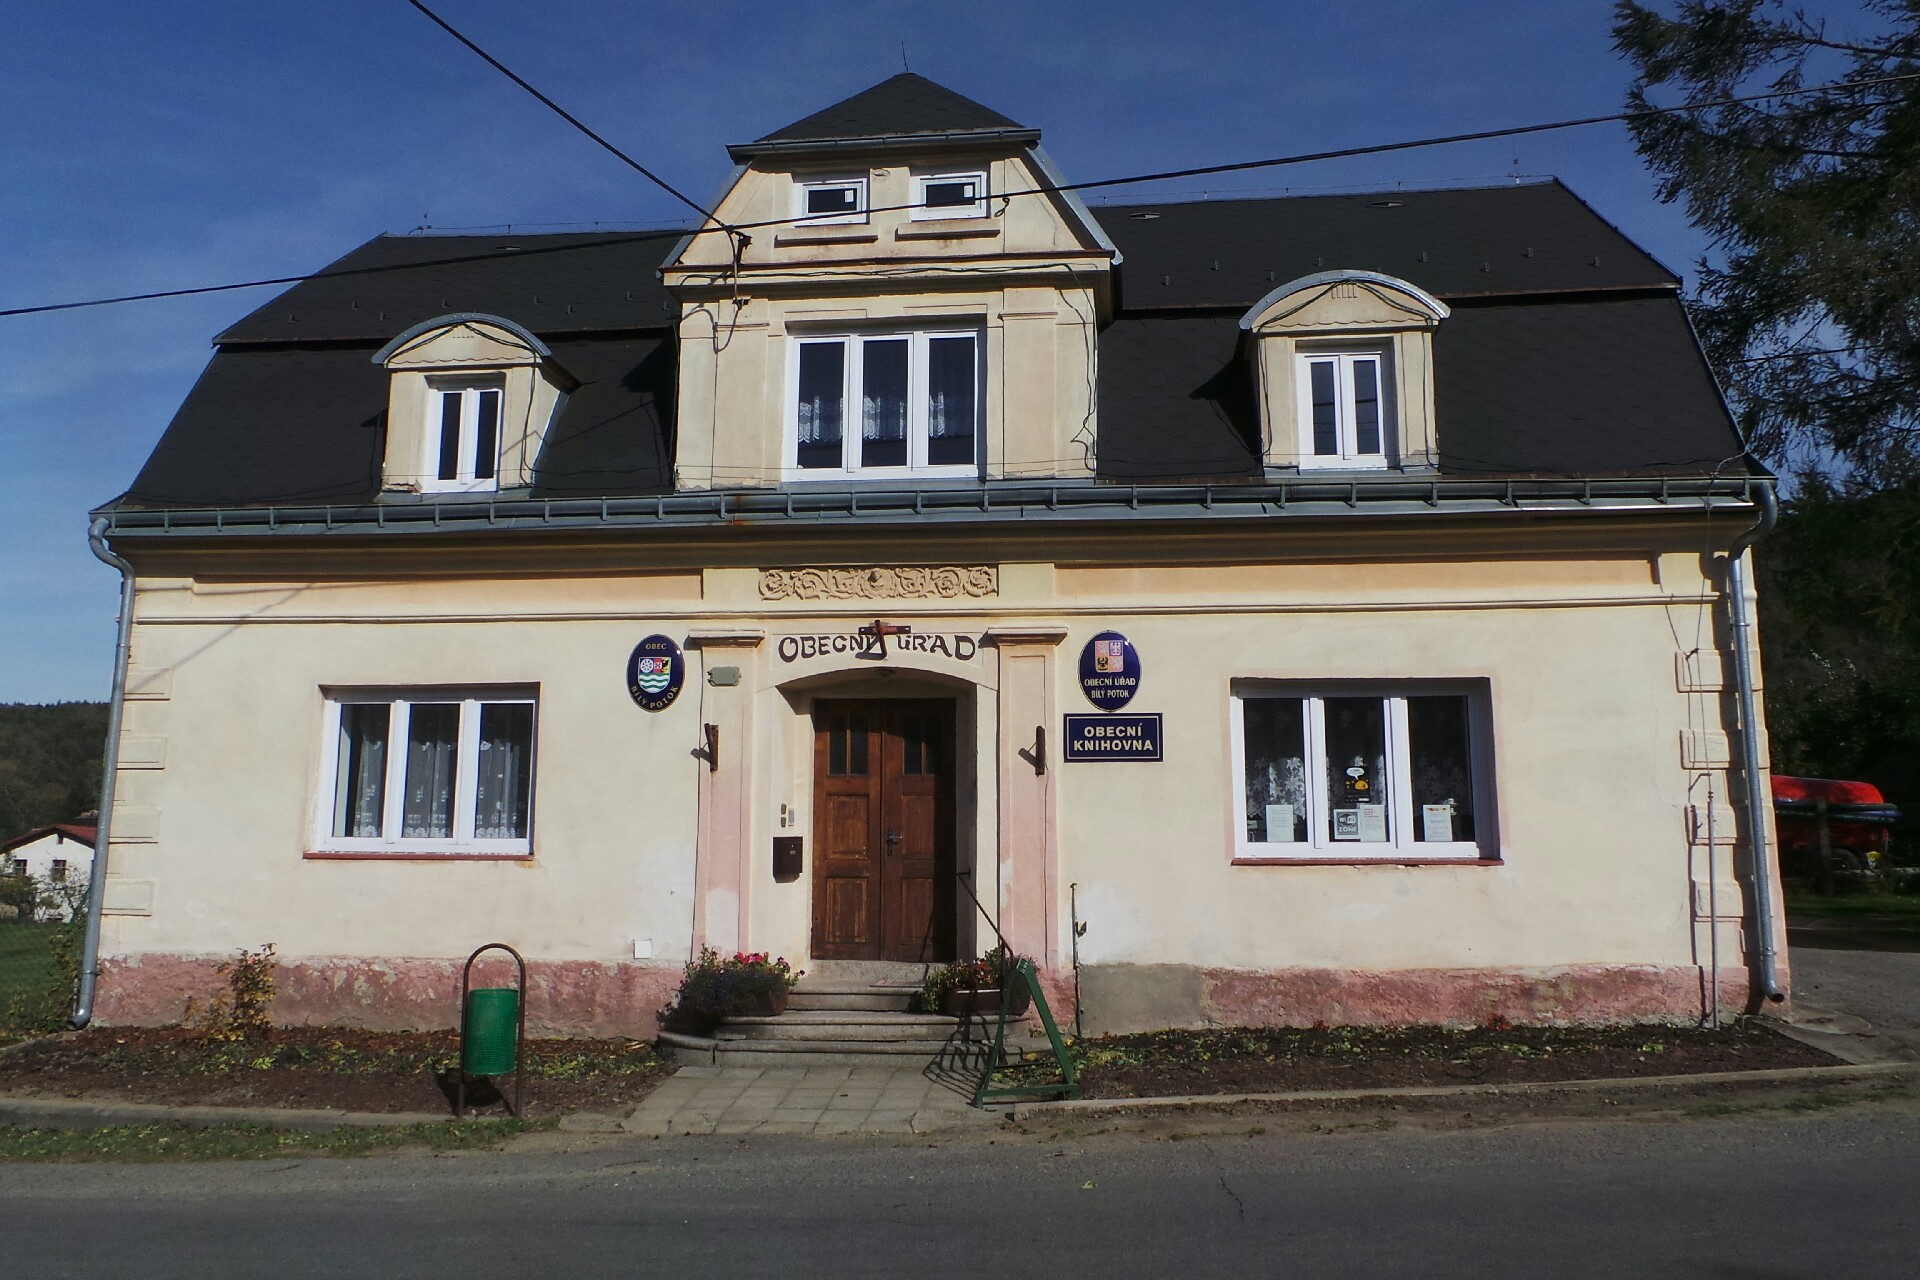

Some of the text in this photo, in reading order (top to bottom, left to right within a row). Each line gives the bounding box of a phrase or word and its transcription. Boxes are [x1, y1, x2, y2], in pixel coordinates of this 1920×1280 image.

[1084, 676, 1136, 686] OBECNÍ ÚŘAD
[650, 687, 678, 708] POTOK
[1091, 688, 1129, 698] BÍLÝ POTOK
[1084, 723, 1143, 737] OBECNÍ
[1073, 740, 1153, 751] KNIHOVNA
